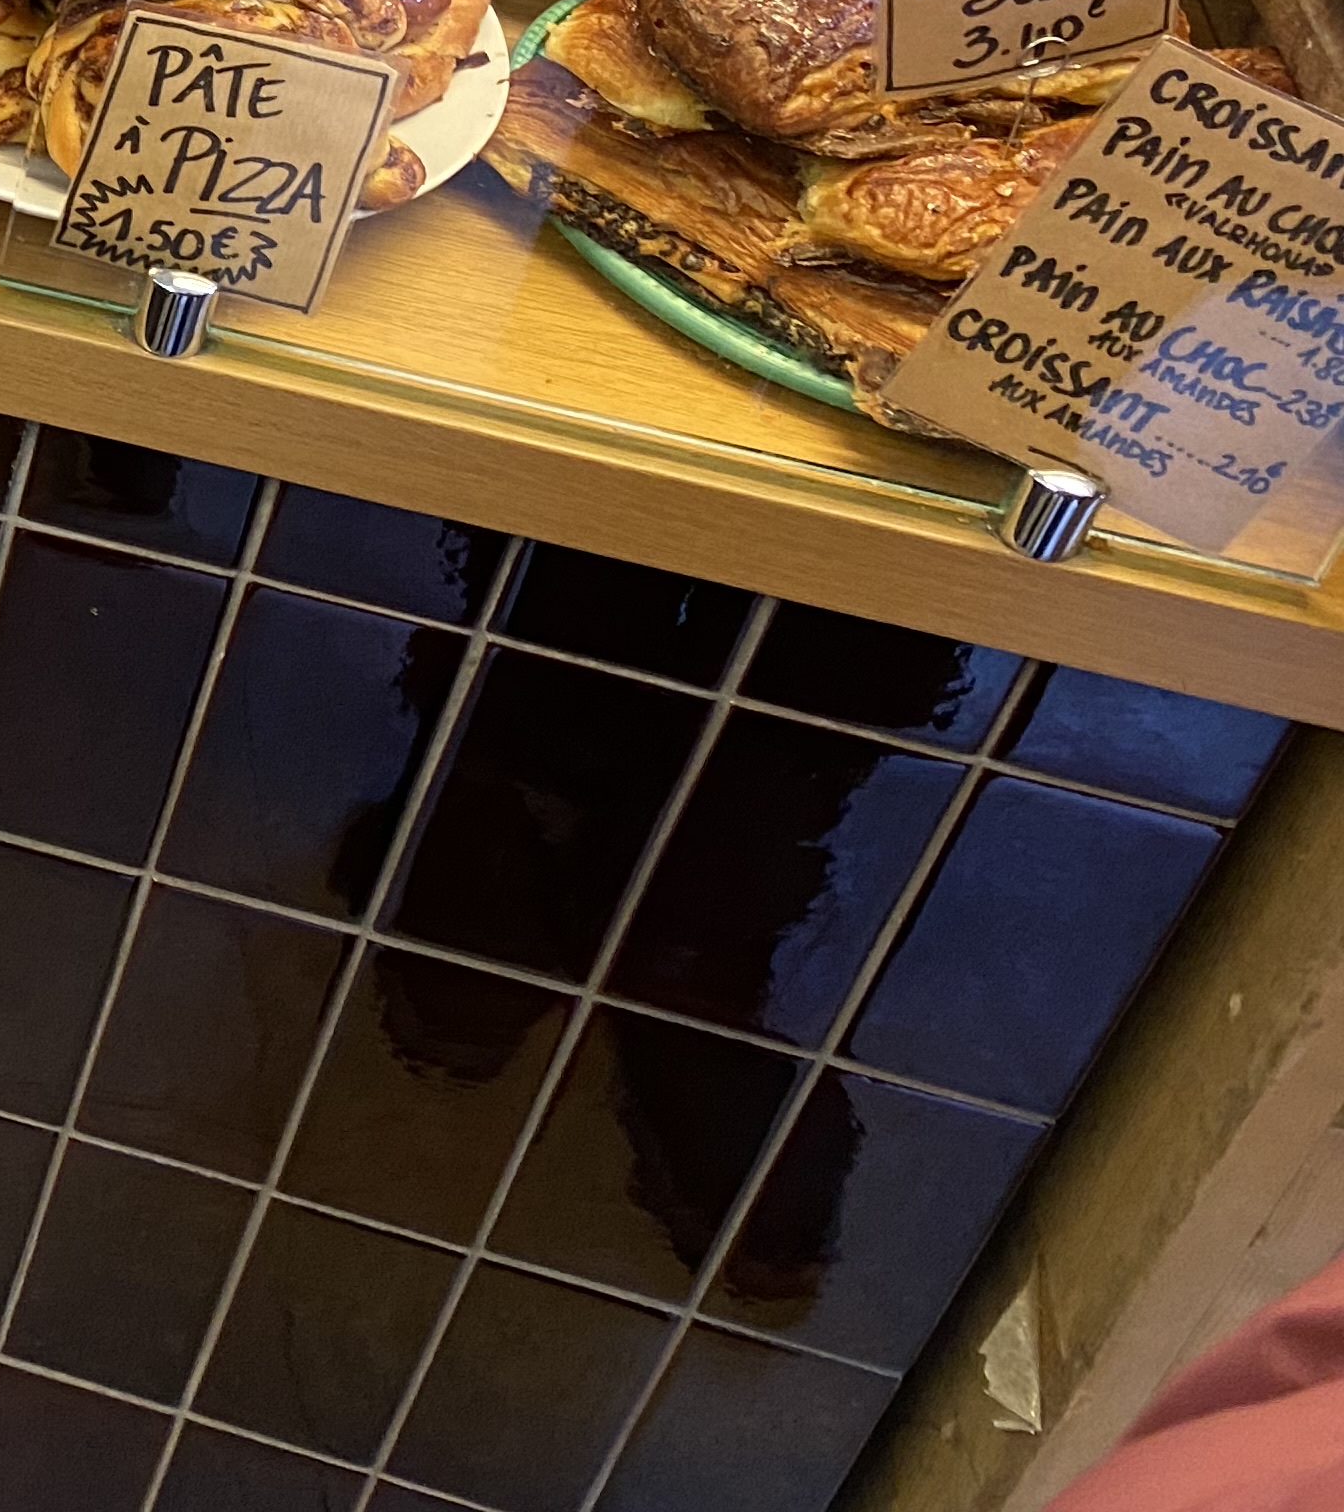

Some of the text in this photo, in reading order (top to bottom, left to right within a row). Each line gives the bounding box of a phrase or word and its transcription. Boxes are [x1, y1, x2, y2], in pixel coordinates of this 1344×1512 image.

[147, 44, 286, 118] PÂTE
[1206, 175, 1271, 217] AU
[100, 208, 239, 261] 1.50€
[1153, 236, 1233, 283] AUX
[1099, 301, 1165, 342] AU
[1159, 326, 1268, 392] CHOC
[988, 373, 1045, 415] AUX
